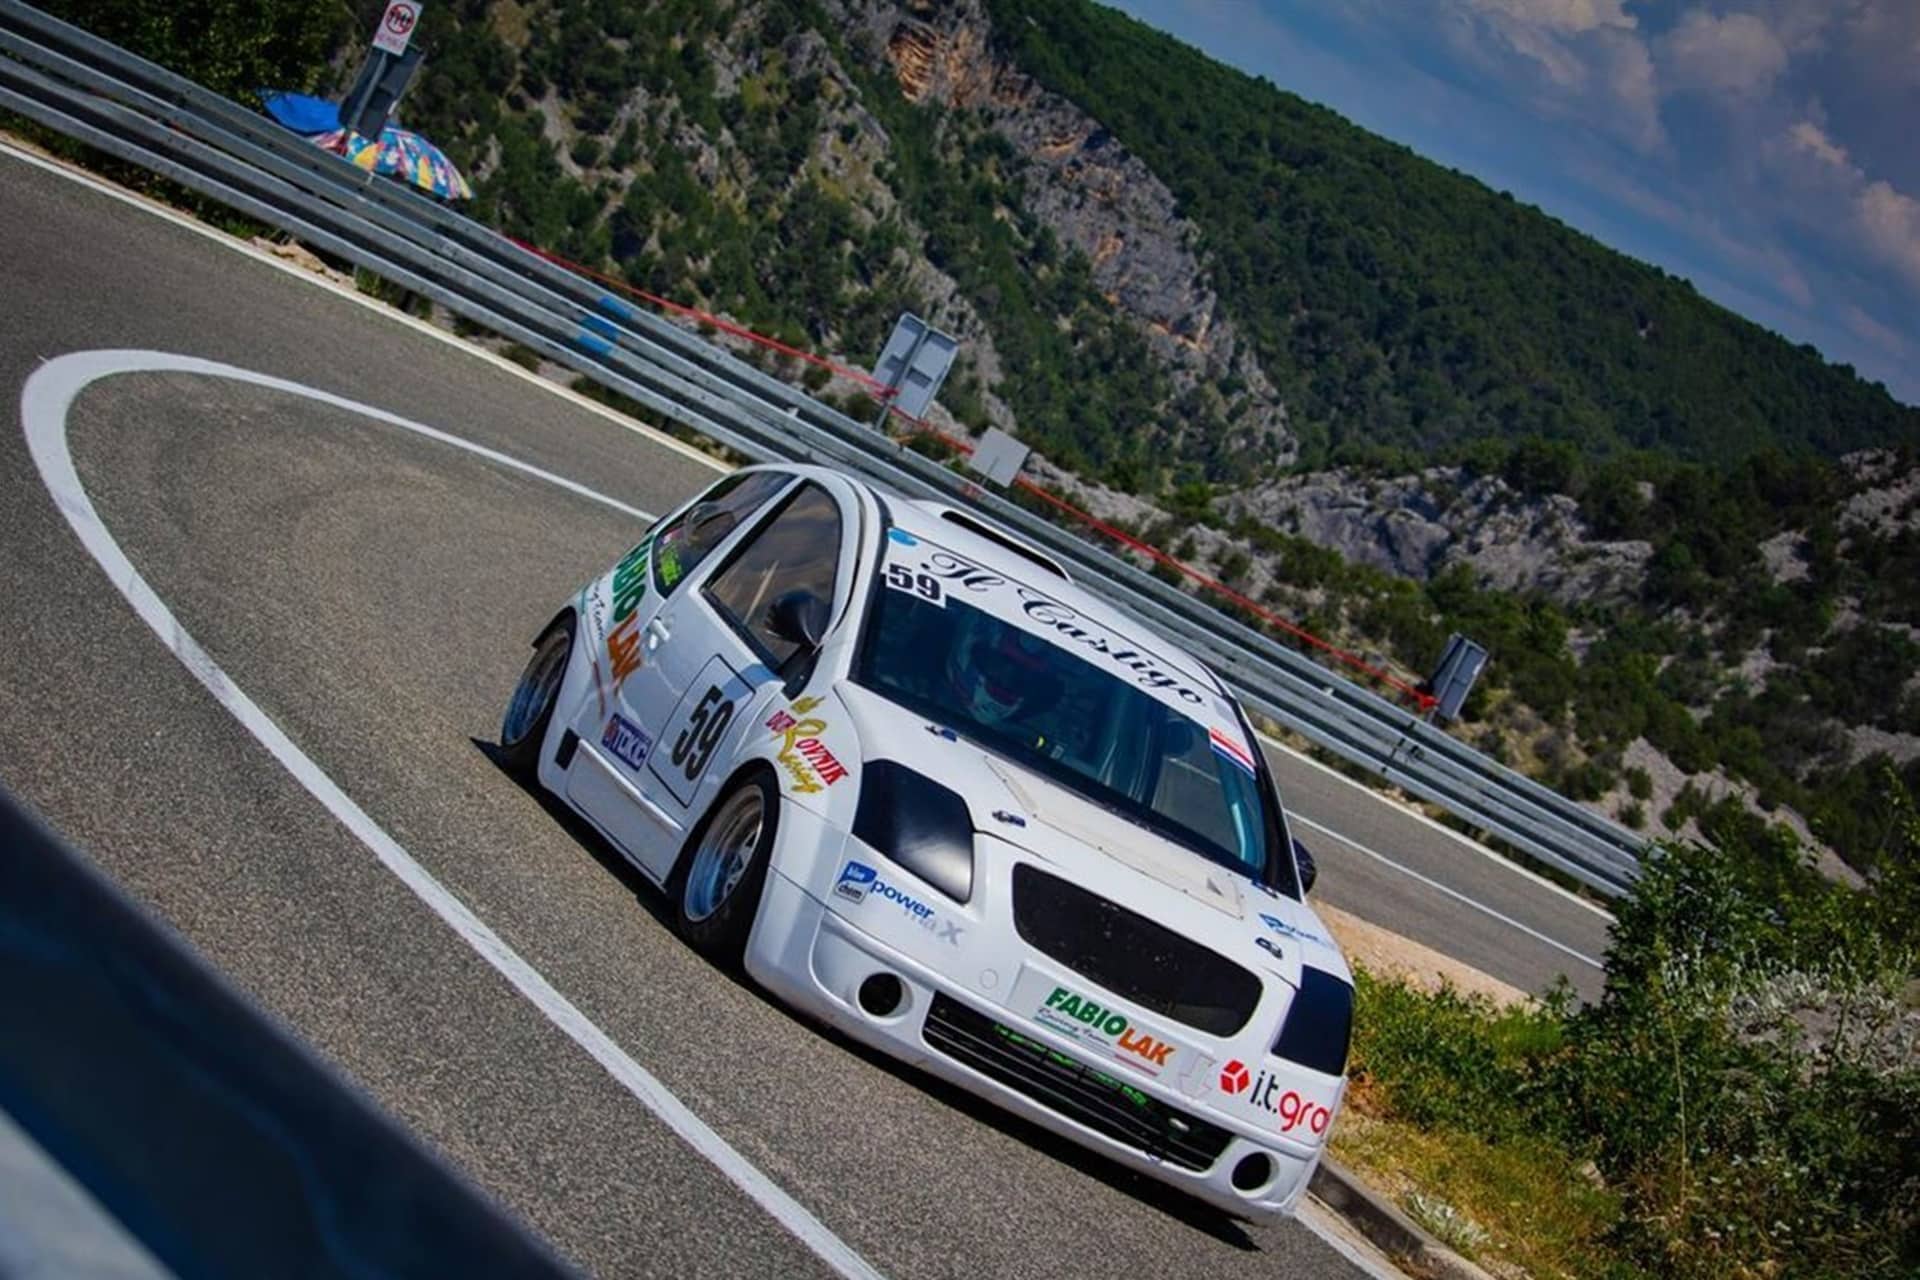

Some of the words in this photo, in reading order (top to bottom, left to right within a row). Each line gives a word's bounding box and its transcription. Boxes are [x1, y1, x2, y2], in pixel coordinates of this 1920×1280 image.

[888, 562, 941, 601] 59
[1016, 588, 1204, 704] Castigo
[672, 684, 735, 781] 59
[869, 880, 935, 920] power
[1045, 986, 1177, 1067] FABIOLAK
